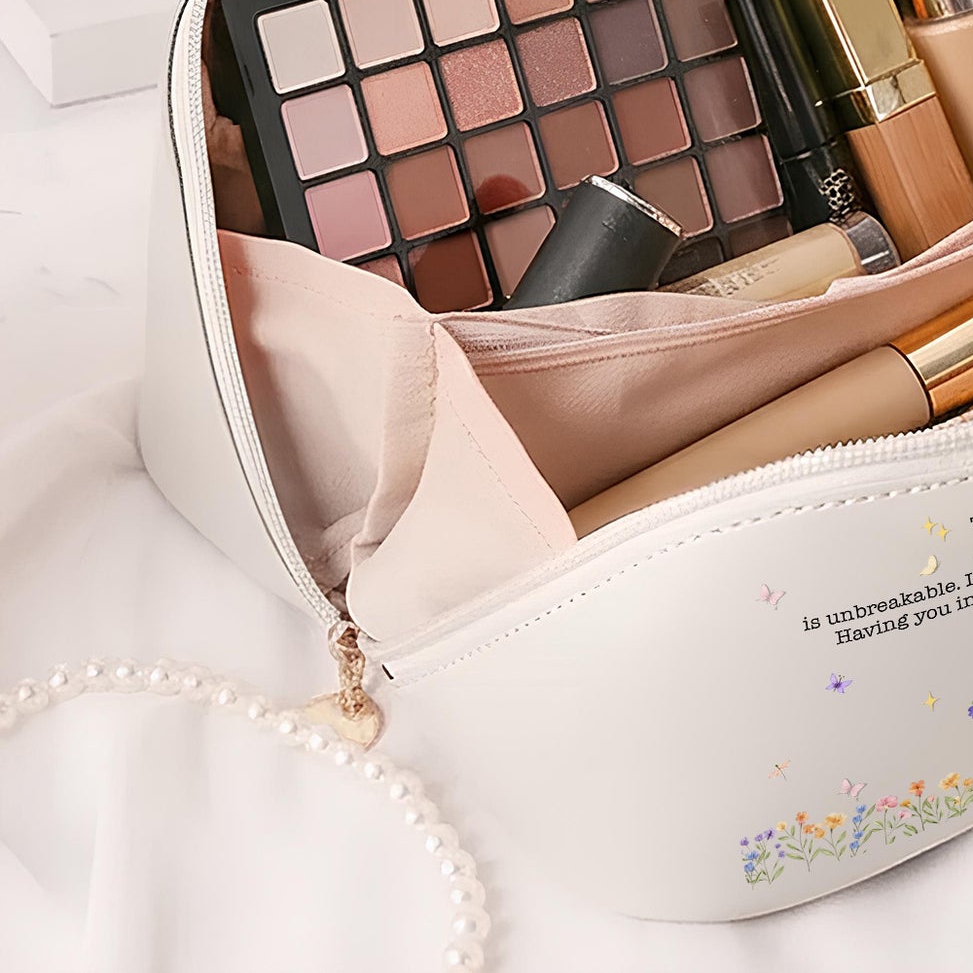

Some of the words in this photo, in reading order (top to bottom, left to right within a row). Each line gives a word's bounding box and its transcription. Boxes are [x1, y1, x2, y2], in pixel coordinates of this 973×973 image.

[802, 616, 821, 632] is
[825, 581, 961, 626] unbreakable.
[834, 613, 910, 646] Having
[912, 603, 953, 627] you
